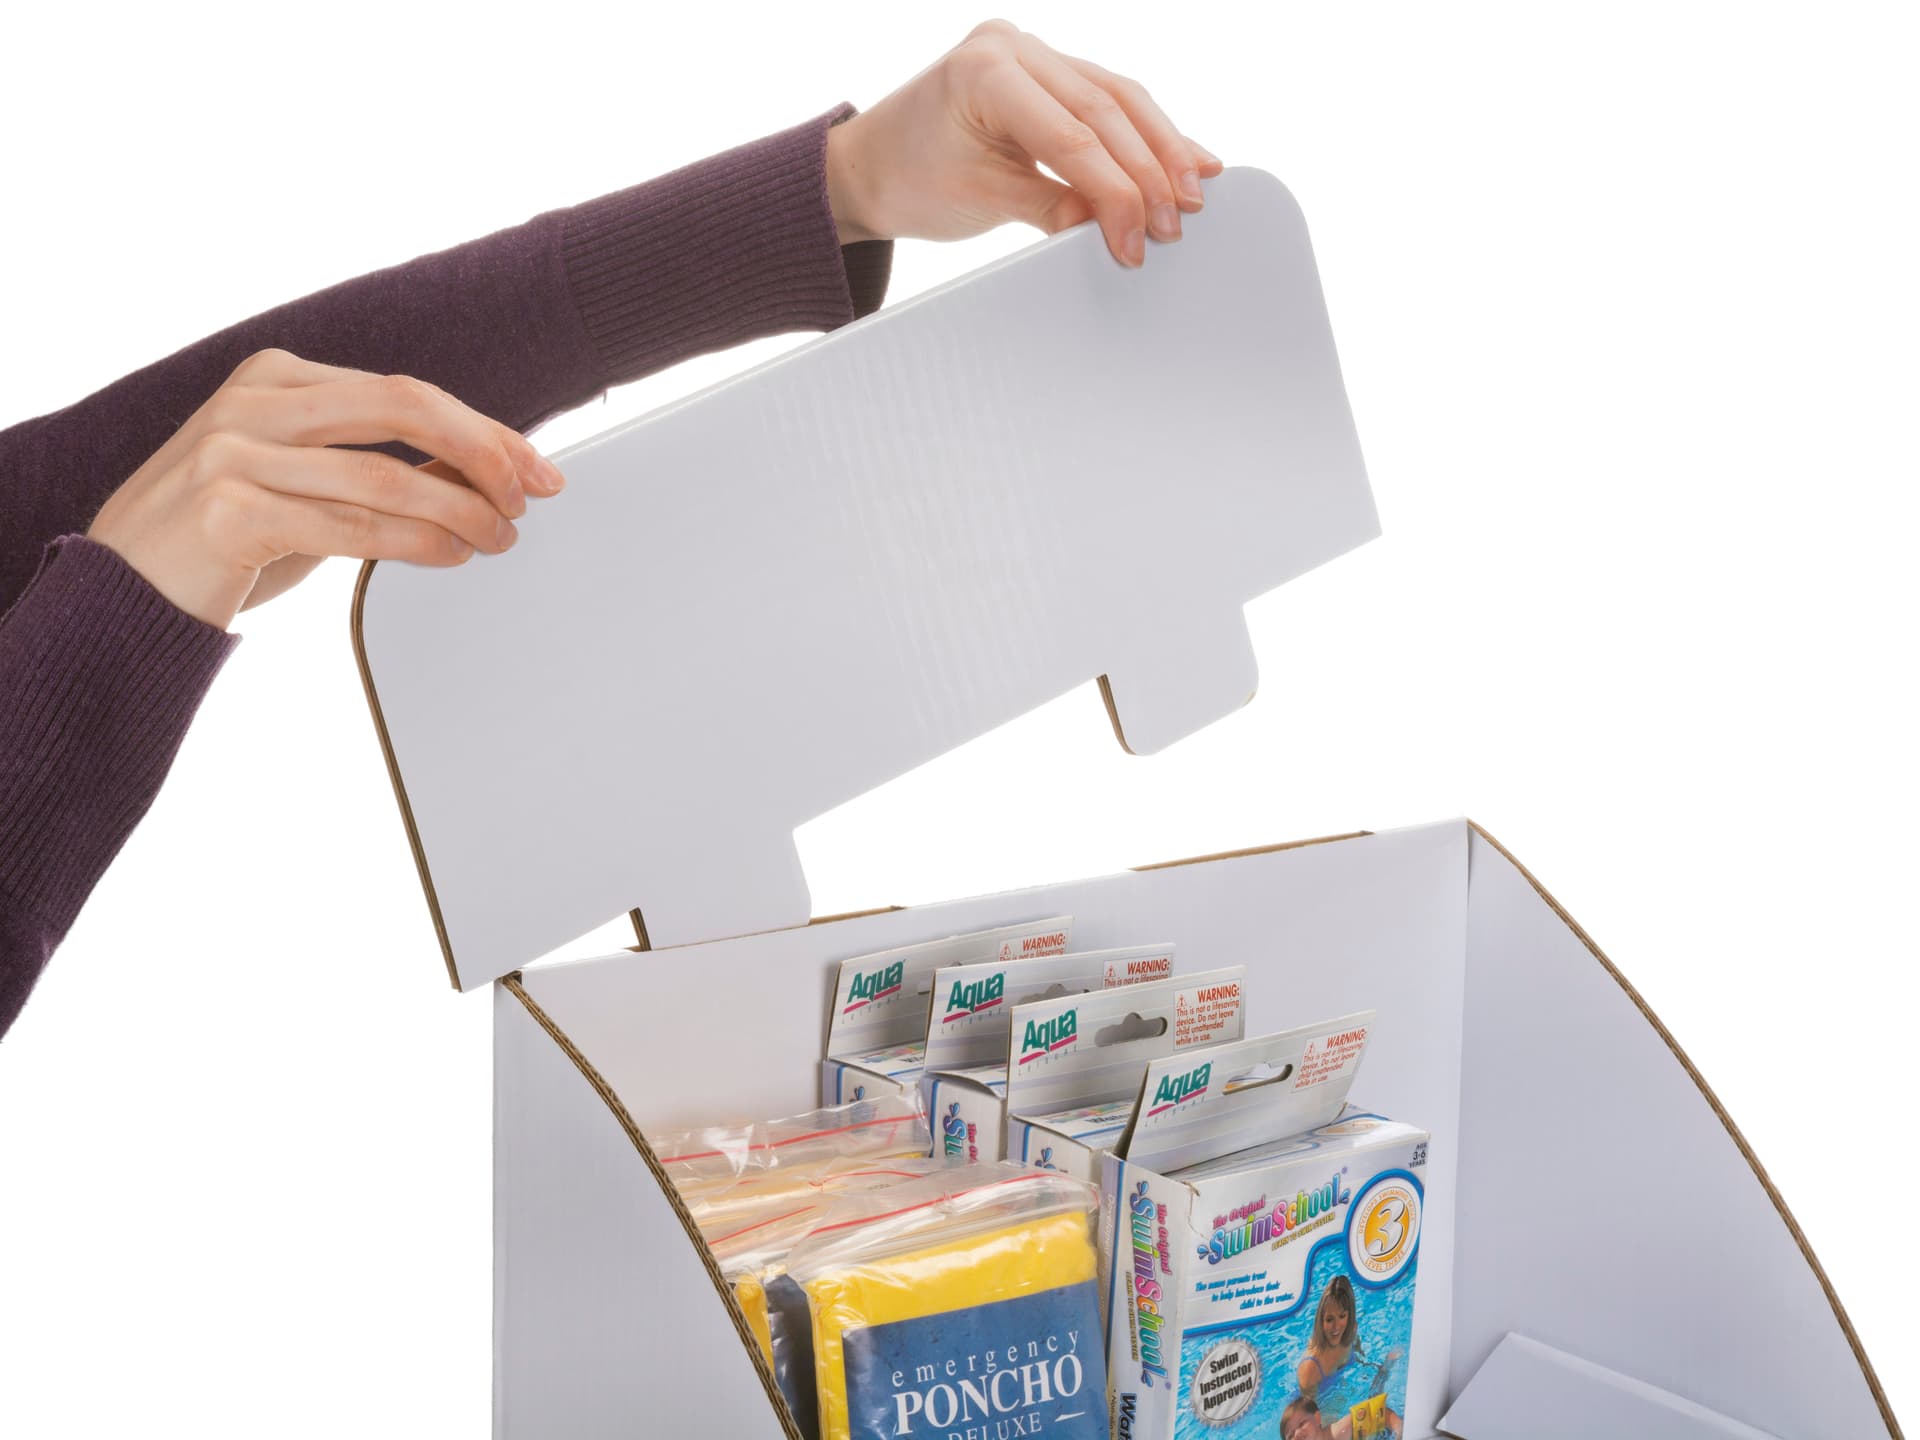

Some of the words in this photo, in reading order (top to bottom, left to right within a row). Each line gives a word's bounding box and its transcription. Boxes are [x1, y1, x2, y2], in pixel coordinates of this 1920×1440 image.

[1023, 933, 1066, 952] WARNING:
[847, 961, 903, 1004] Aqua
[1127, 958, 1170, 976] WARNING:
[946, 972, 1004, 1014] Aqua
[1176, 1008, 1188, 1017] This
[1196, 1004, 1206, 1014] not
[1212, 999, 1240, 1010] lifesaving
[1198, 984, 1240, 1003] WARNING:
[1021, 1009, 1077, 1054] Aqua
[1176, 1016, 1196, 1027] device.
[1198, 1014, 1207, 1023] Do
[1208, 1012, 1217, 1021] not
[1218, 1010, 1234, 1019] leave
[1176, 1026, 1190, 1037] child
[1327, 1028, 1367, 1049] WARNING:
[1152, 1062, 1211, 1106] Aqua
[1413, 1150, 1426, 1160] 3-6
[1208, 1173, 1340, 1265] SwimSchool
[1213, 1213, 1228, 1230] The
[1229, 1194, 1266, 1222] Original
[1366, 1198, 1406, 1257] 3
[1157, 1226, 1173, 1276] Original
[1365, 1257, 1383, 1270] LEVEL
[1130, 1192, 1167, 1378] SwimSchool
[892, 1330, 1079, 1388] emergency
[1210, 1352, 1239, 1374] Swim
[892, 1353, 1083, 1436] PONCHO
[1200, 1362, 1252, 1396] Instructor
[1203, 1377, 1253, 1411] Approved
